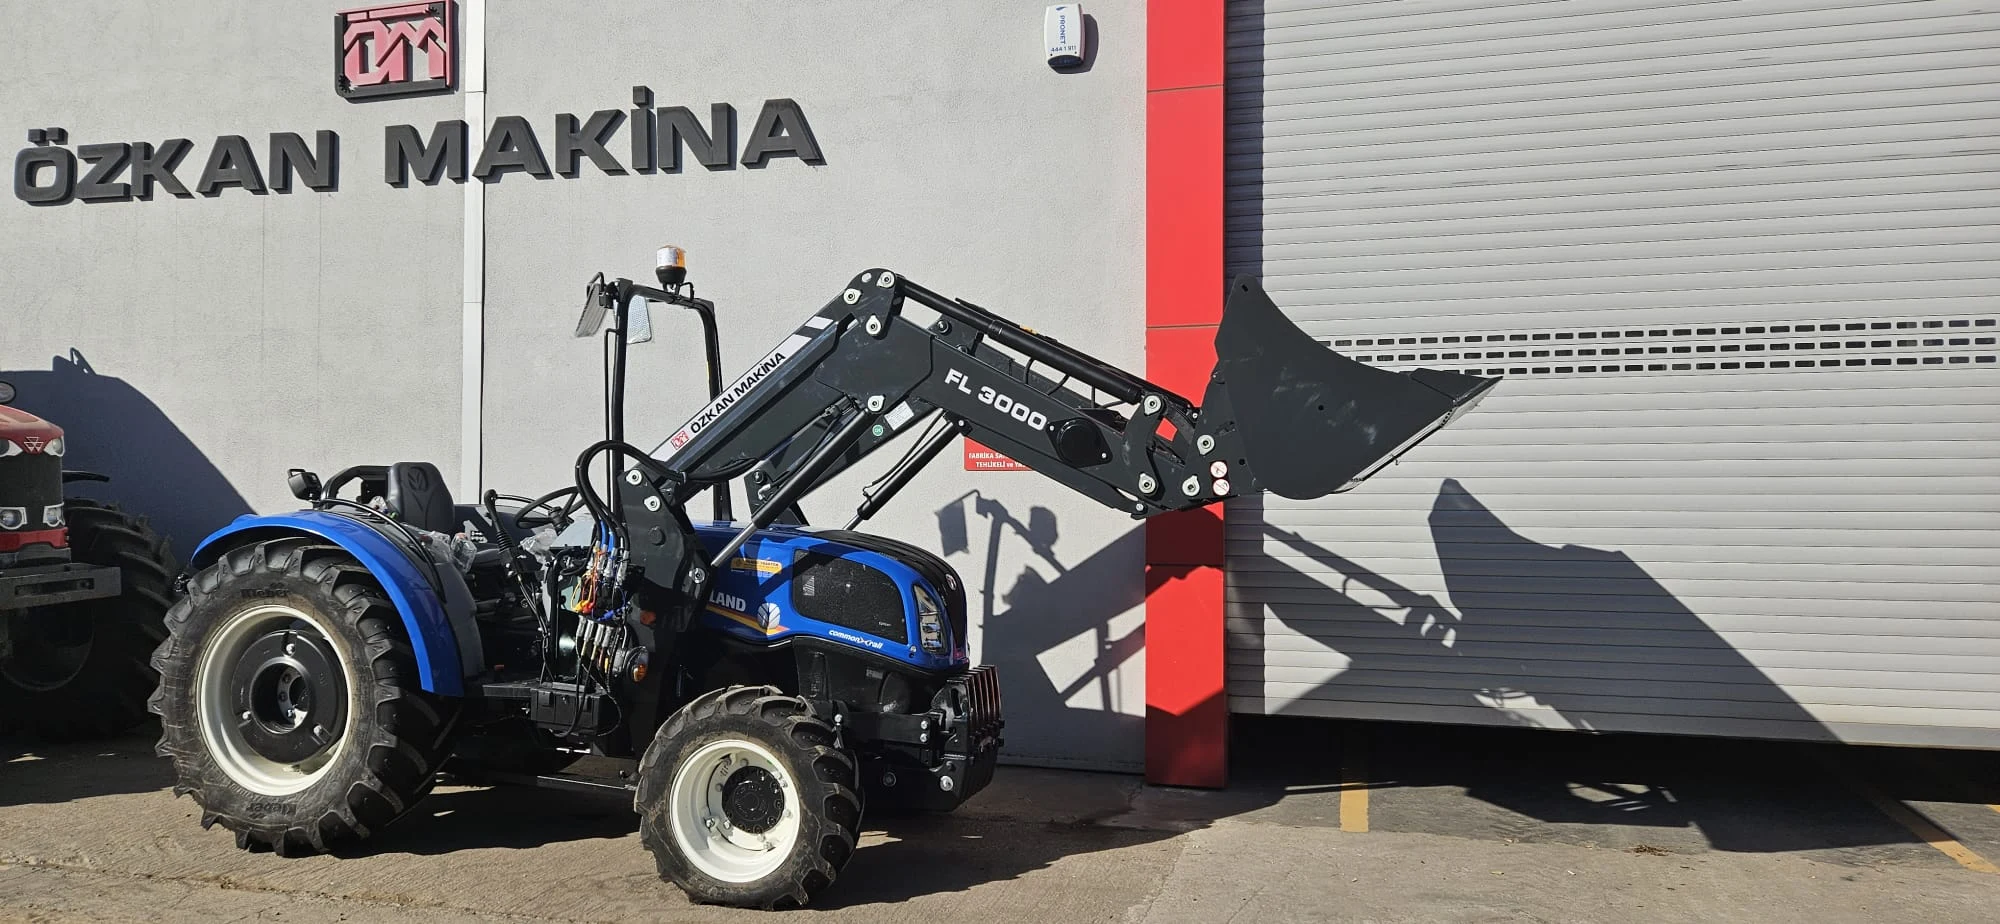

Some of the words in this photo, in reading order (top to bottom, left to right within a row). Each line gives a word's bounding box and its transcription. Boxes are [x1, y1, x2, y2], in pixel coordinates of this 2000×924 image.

[14, 127, 339, 206] ÖZKAN
[384, 85, 827, 188] MAKİNA
[690, 393, 736, 433] ÖZKAN
[734, 352, 787, 397] MAKİNA
[944, 368, 972, 395] FL
[977, 385, 1048, 431] 3000
[976, 460, 1006, 468] TEHLİKELİ
